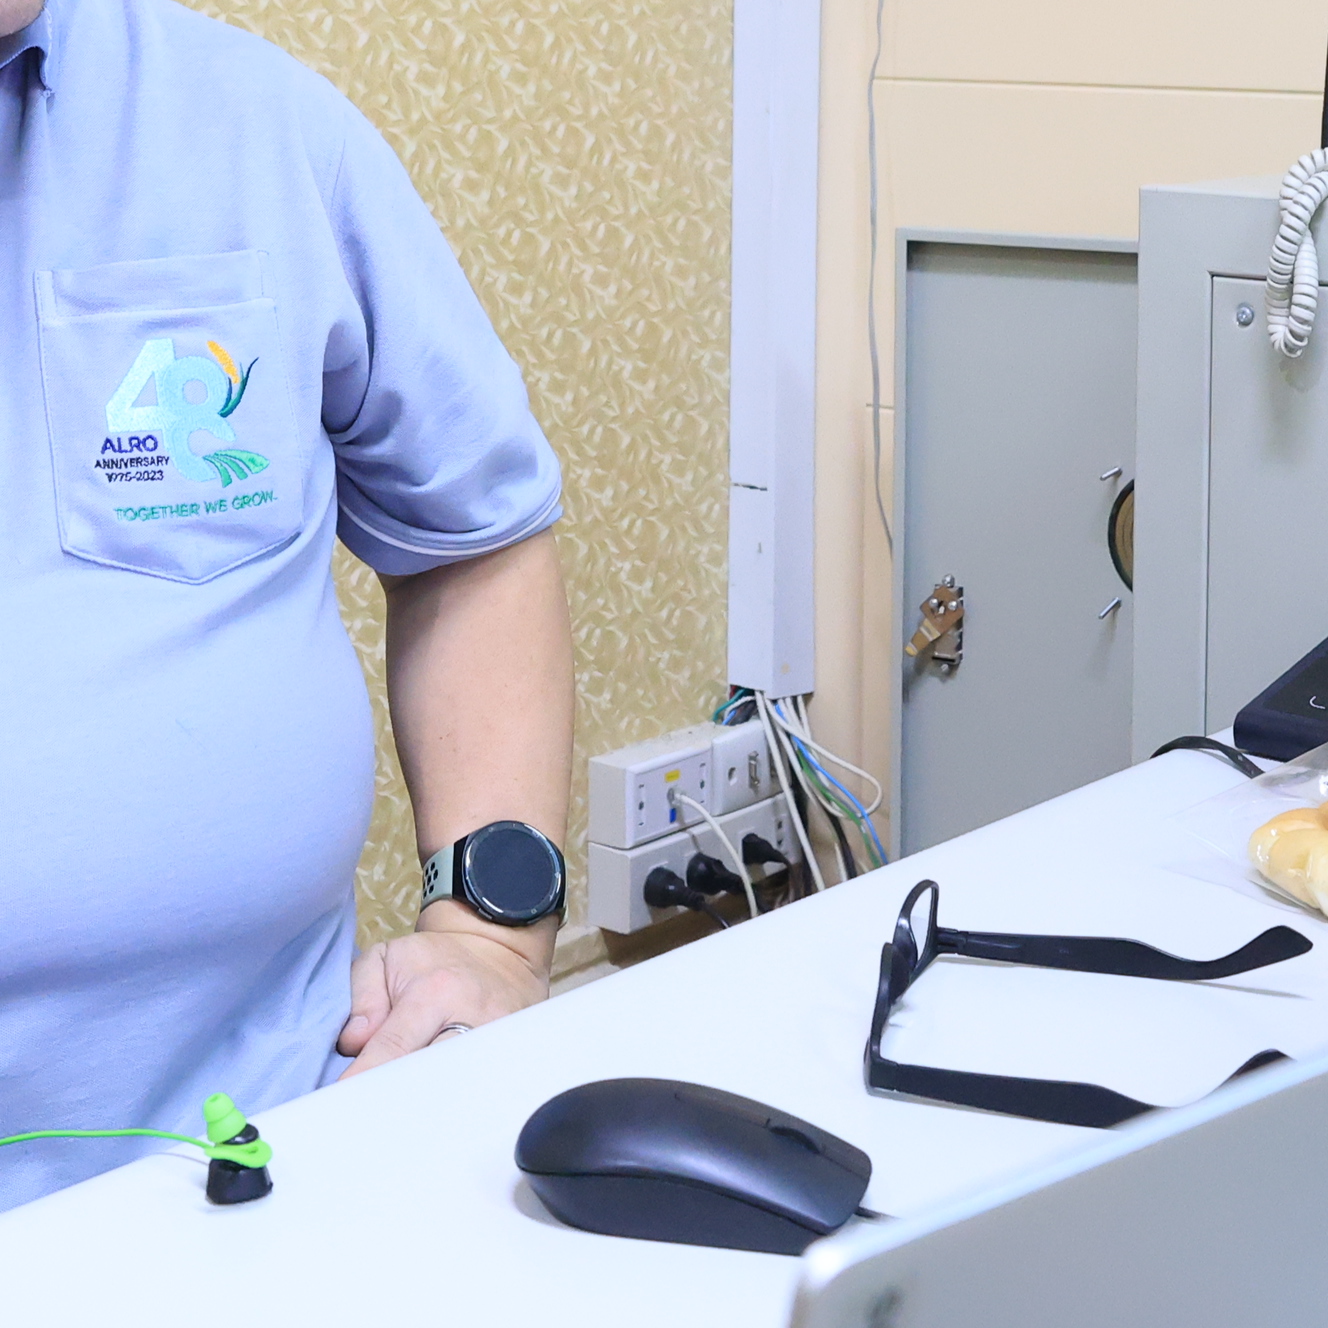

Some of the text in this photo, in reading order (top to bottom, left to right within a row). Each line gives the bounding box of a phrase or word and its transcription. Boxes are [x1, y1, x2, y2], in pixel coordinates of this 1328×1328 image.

[100, 434, 159, 455] ALRO
[94, 455, 170, 470] ANNIVERSARY
[105, 469, 164, 484] 1975-2023
[114, 502, 200, 522] TOGETHER
[203, 498, 228, 514] WE
